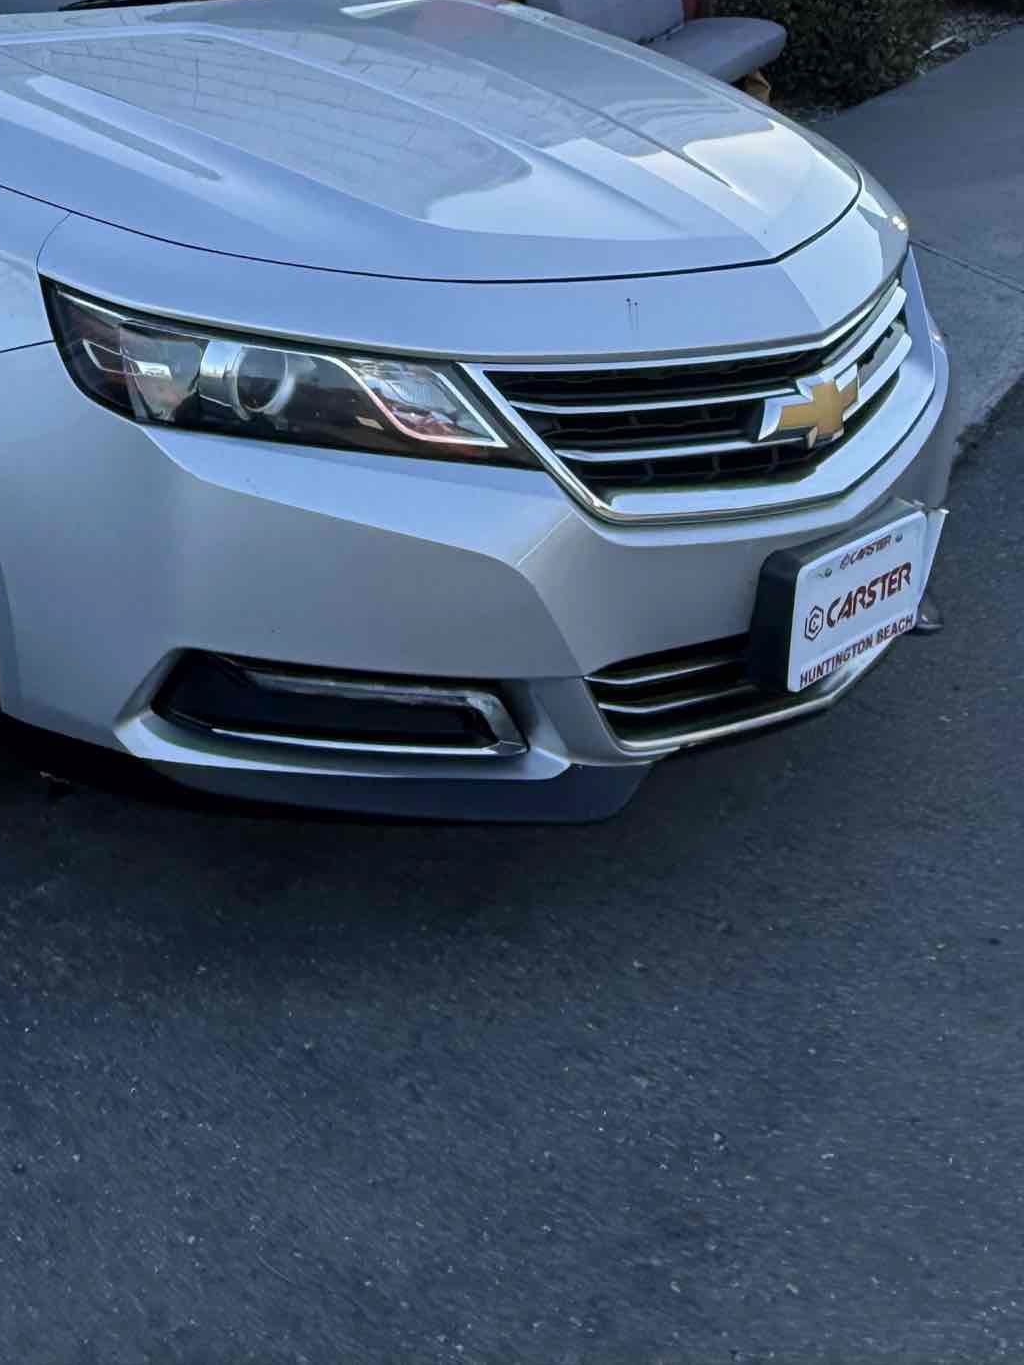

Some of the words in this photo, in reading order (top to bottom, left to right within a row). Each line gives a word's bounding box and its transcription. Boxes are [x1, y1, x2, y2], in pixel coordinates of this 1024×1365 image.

[826, 561, 912, 628] CARSTER
[799, 633, 873, 688] HUNTINGTON
[877, 613, 914, 642] BEACH
